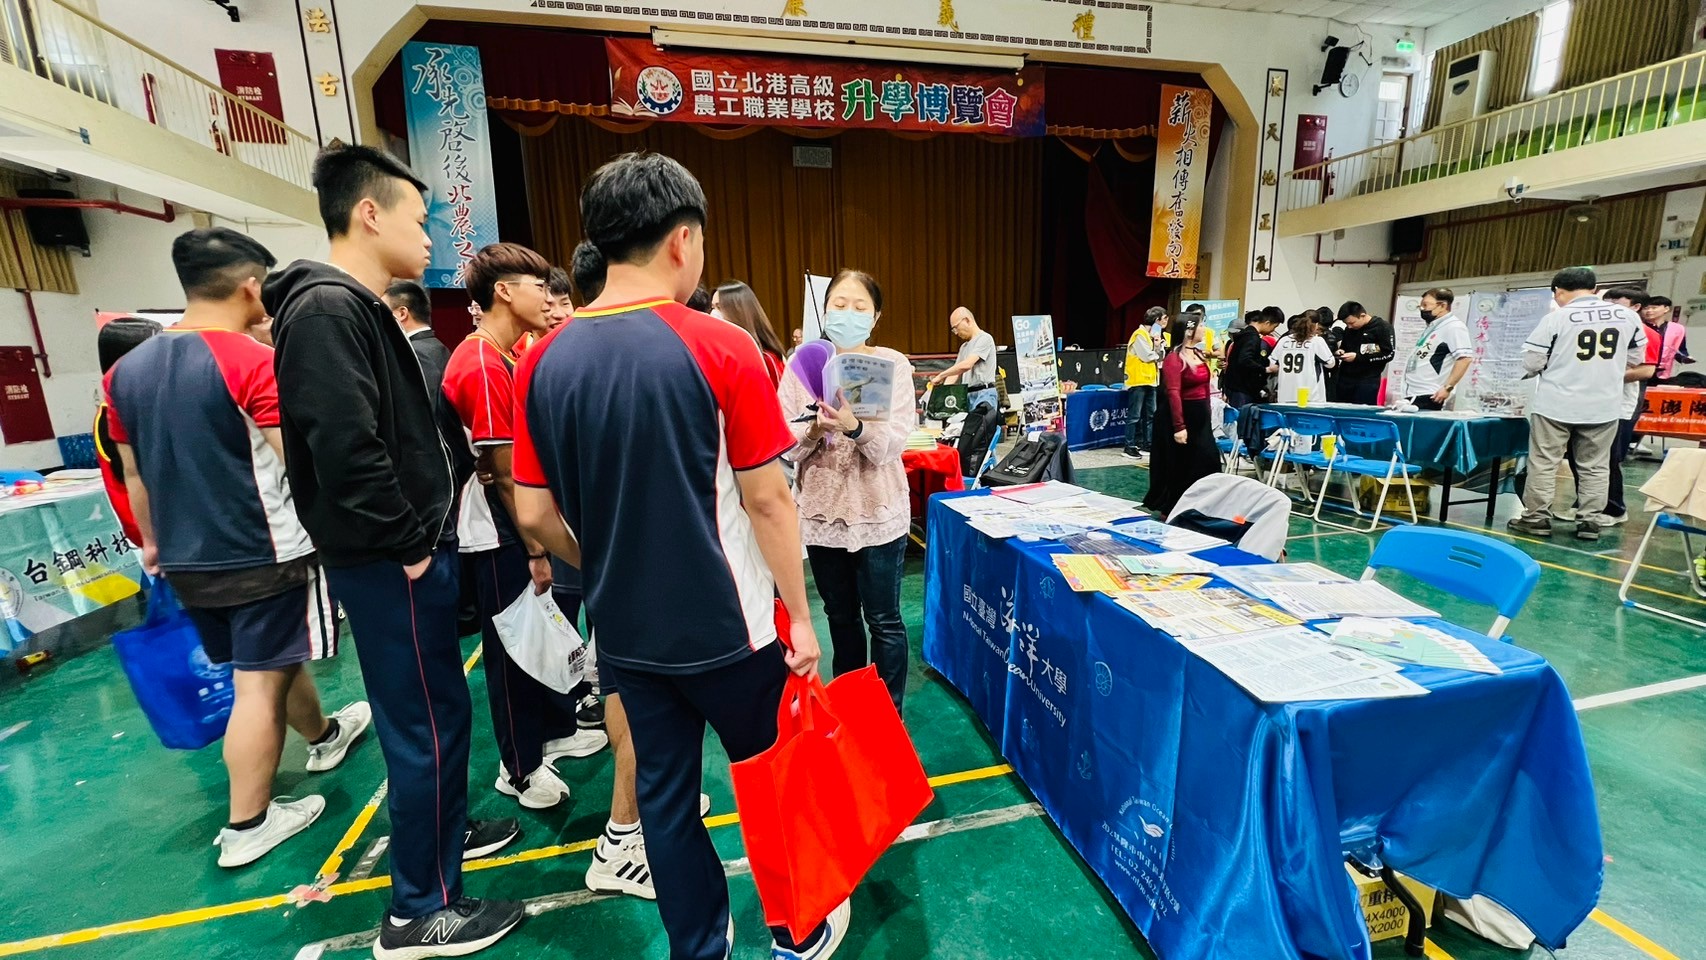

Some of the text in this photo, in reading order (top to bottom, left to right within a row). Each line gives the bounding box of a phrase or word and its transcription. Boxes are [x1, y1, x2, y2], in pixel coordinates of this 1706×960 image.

[690, 69, 835, 97] 國立北港高級
[693, 94, 836, 121] 農工職業學校
[841, 78, 1018, 128] 升學博覽會
[1569, 309, 1627, 323] CTBC
[1282, 340, 1312, 349] CTBC
[1576, 327, 1620, 361] 99
[1283, 352, 1305, 374] 99
[1030, 676, 1067, 728] University
